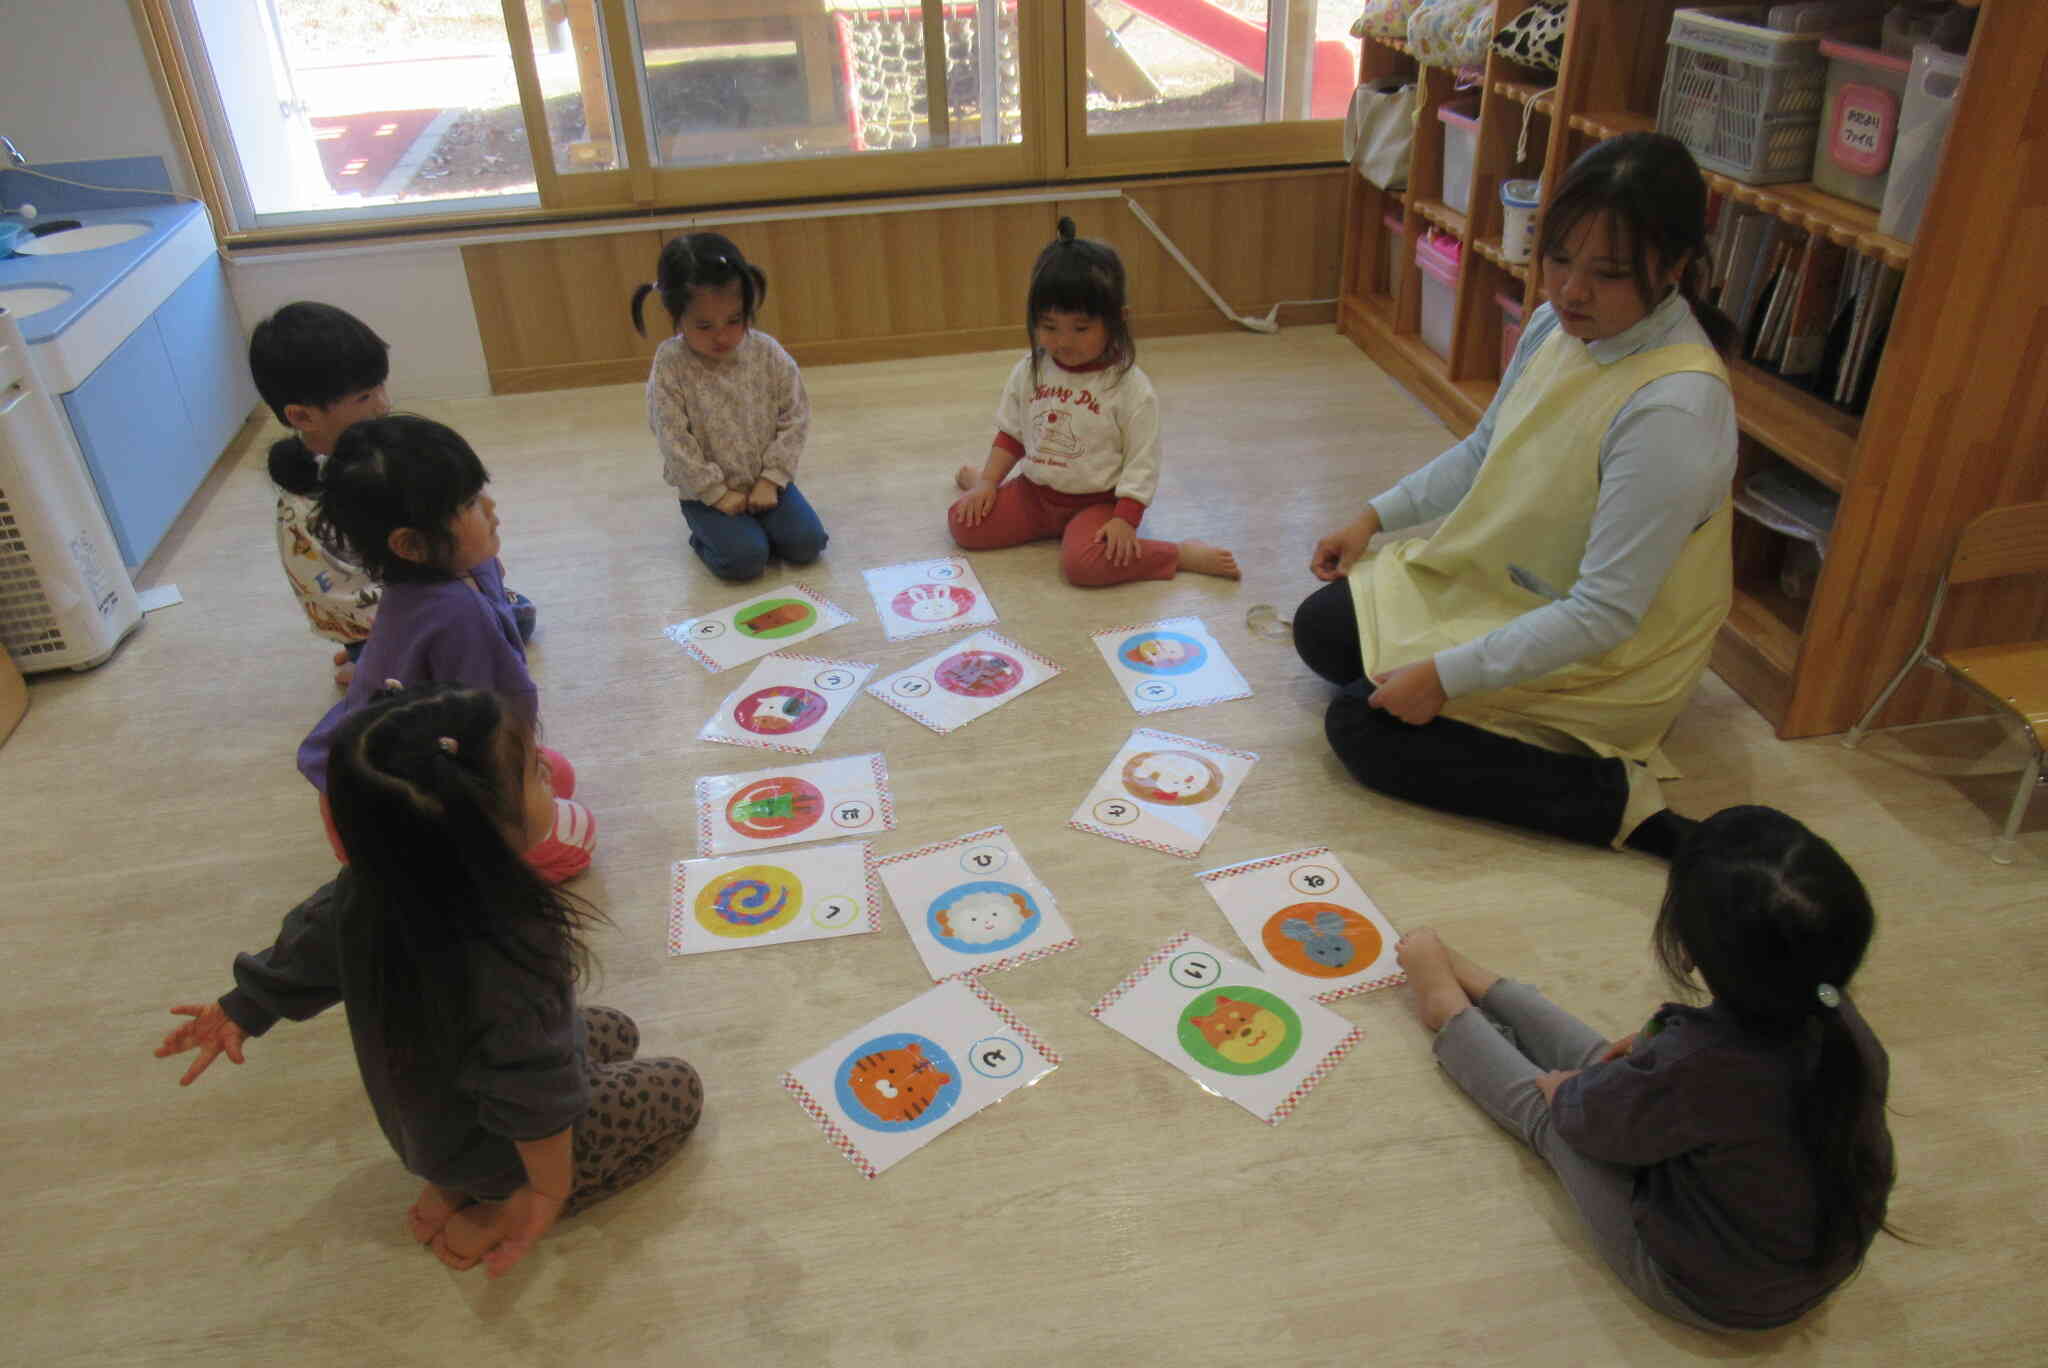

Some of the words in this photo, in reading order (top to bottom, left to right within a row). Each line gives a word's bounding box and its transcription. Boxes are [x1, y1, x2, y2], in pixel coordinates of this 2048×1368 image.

[1845, 129, 1873, 147] ファイル
[1108, 805, 1126, 817] と
[972, 854, 993, 867] ひ
[1303, 874, 1325, 889] ね
[826, 905, 841, 919] へ
[1184, 962, 1207, 979] い
[982, 1049, 1007, 1068] と
